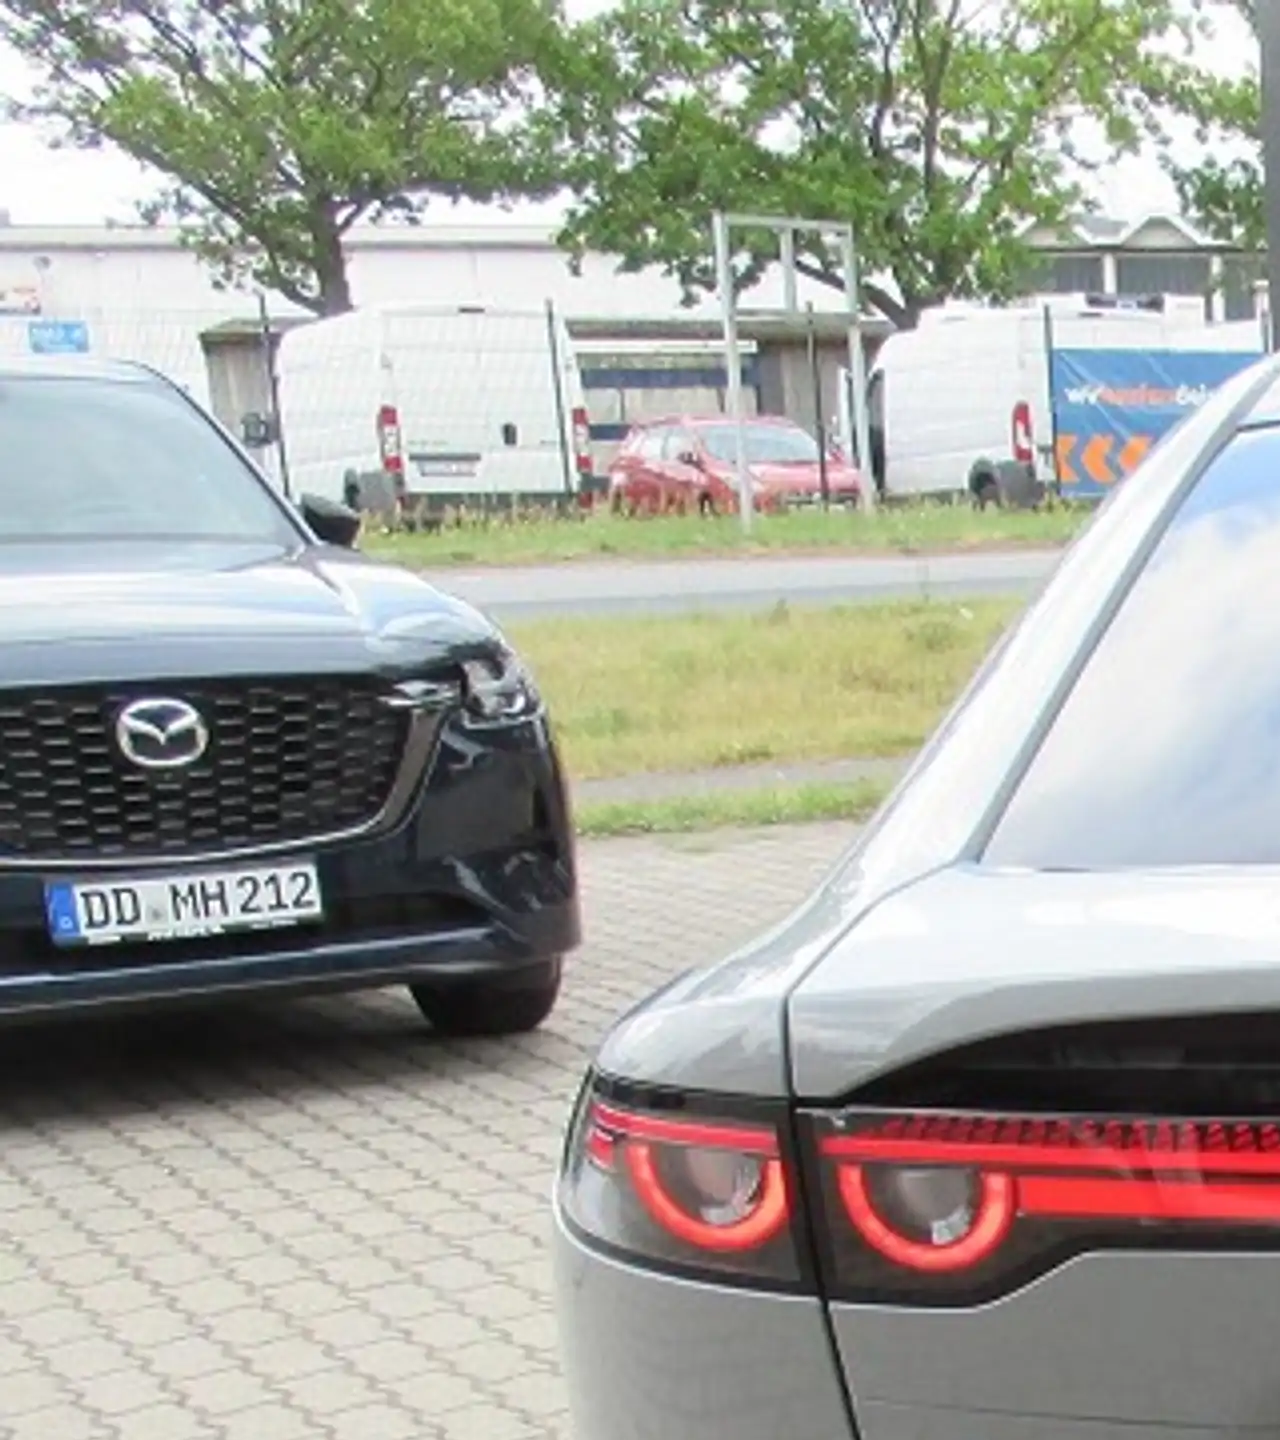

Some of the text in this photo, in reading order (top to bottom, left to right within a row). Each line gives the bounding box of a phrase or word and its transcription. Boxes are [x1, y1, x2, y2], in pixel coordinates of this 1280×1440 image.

[79, 870, 316, 929] DD MH 212
